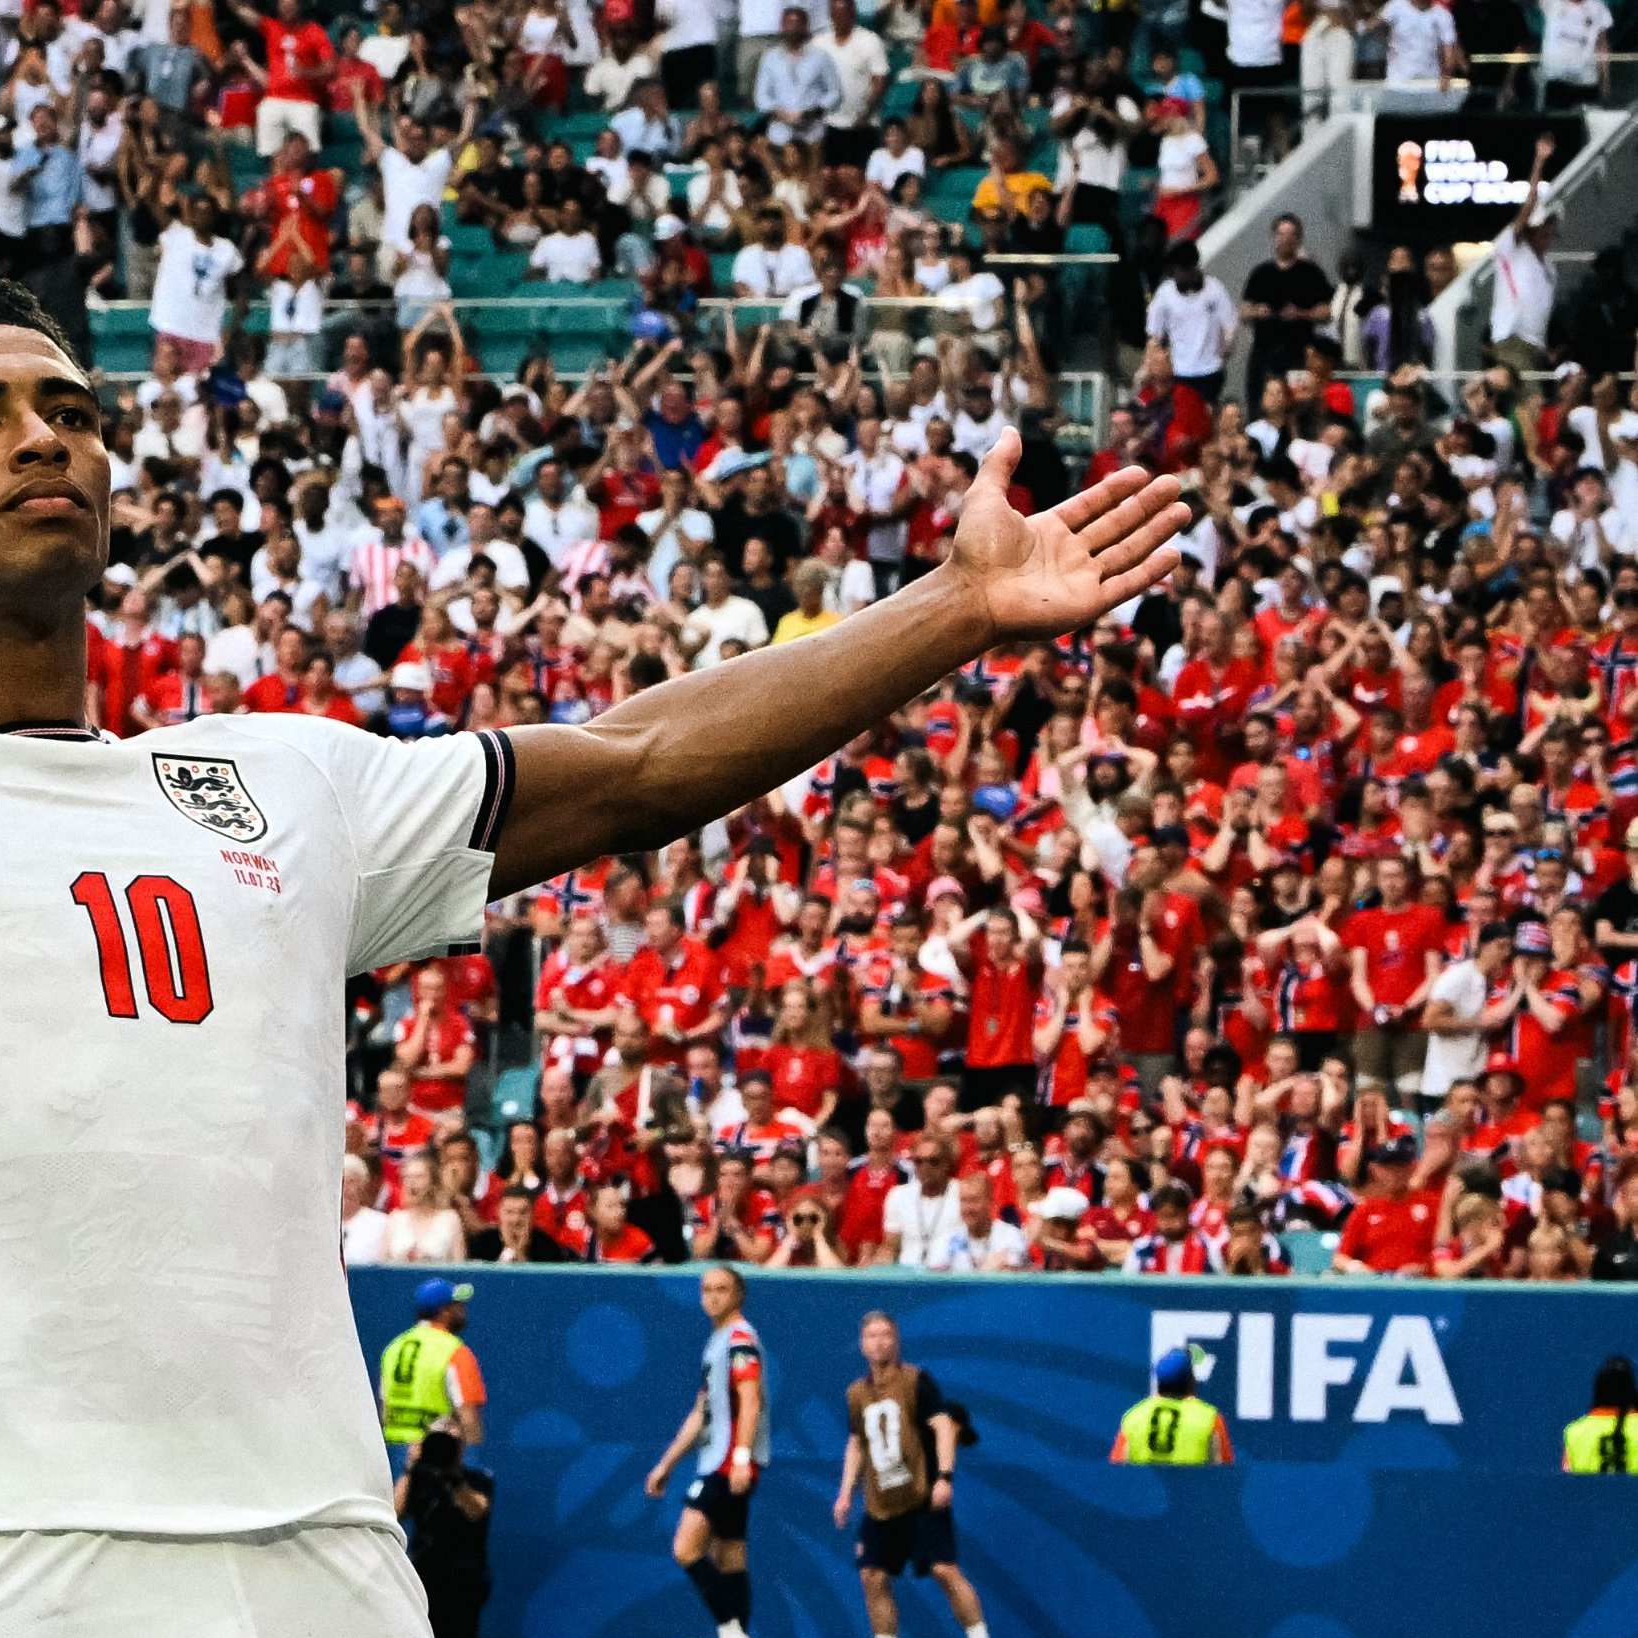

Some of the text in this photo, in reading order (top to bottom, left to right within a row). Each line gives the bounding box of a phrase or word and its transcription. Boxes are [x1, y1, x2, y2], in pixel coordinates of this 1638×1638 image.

[220, 849, 279, 873] NORWAY
[69, 871, 214, 1024] 10
[1150, 1310, 1463, 1425] FIFA
